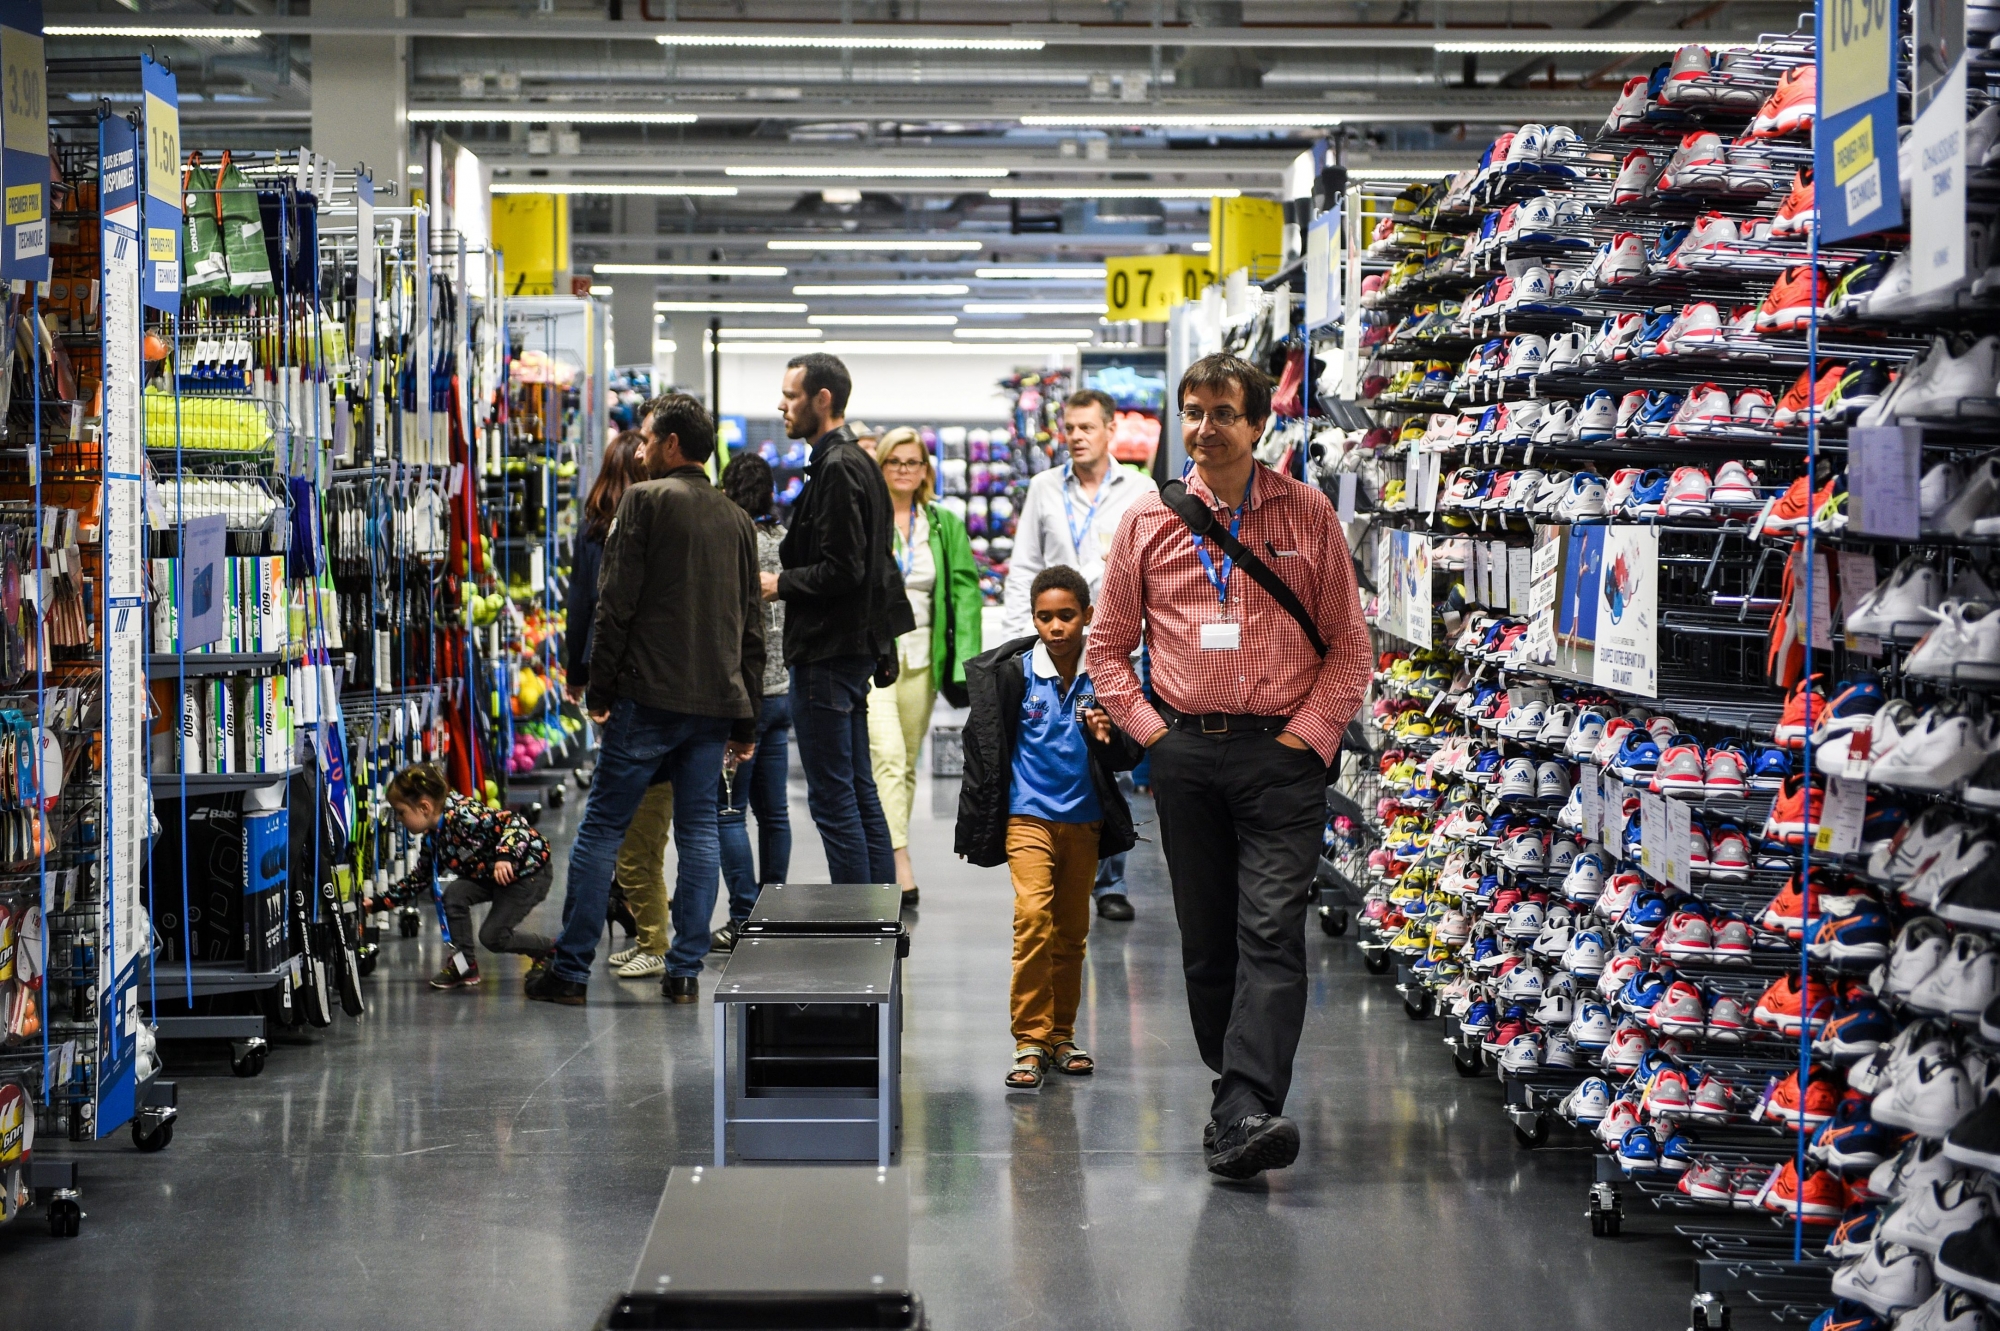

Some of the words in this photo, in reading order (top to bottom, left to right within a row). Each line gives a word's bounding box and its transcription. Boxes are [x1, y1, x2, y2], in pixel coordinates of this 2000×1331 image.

[9, 64, 40, 120] 3.90
[103, 155, 113, 170] PLUS
[152, 127, 175, 176] 1.50
[103, 166, 134, 194] DISPONIBLES
[1849, 174, 1877, 210] TECHNIQUE
[8, 196, 28, 215] PREMIER
[28, 193, 39, 211] PRIX
[19, 228, 43, 250] TECHNIQUE
[150, 236, 165, 252] PREMIER
[189, 212, 199, 253] RTENGO
[158, 268, 177, 285] TECHNIQUE
[1113, 269, 1153, 309] 07
[1526, 287, 1547, 295] adidas
[262, 592, 271, 615] 600
[184, 683, 193, 714] MAVIS
[184, 714, 194, 738] 600
[265, 712, 273, 736] 600
[209, 809, 238, 819] Bab
